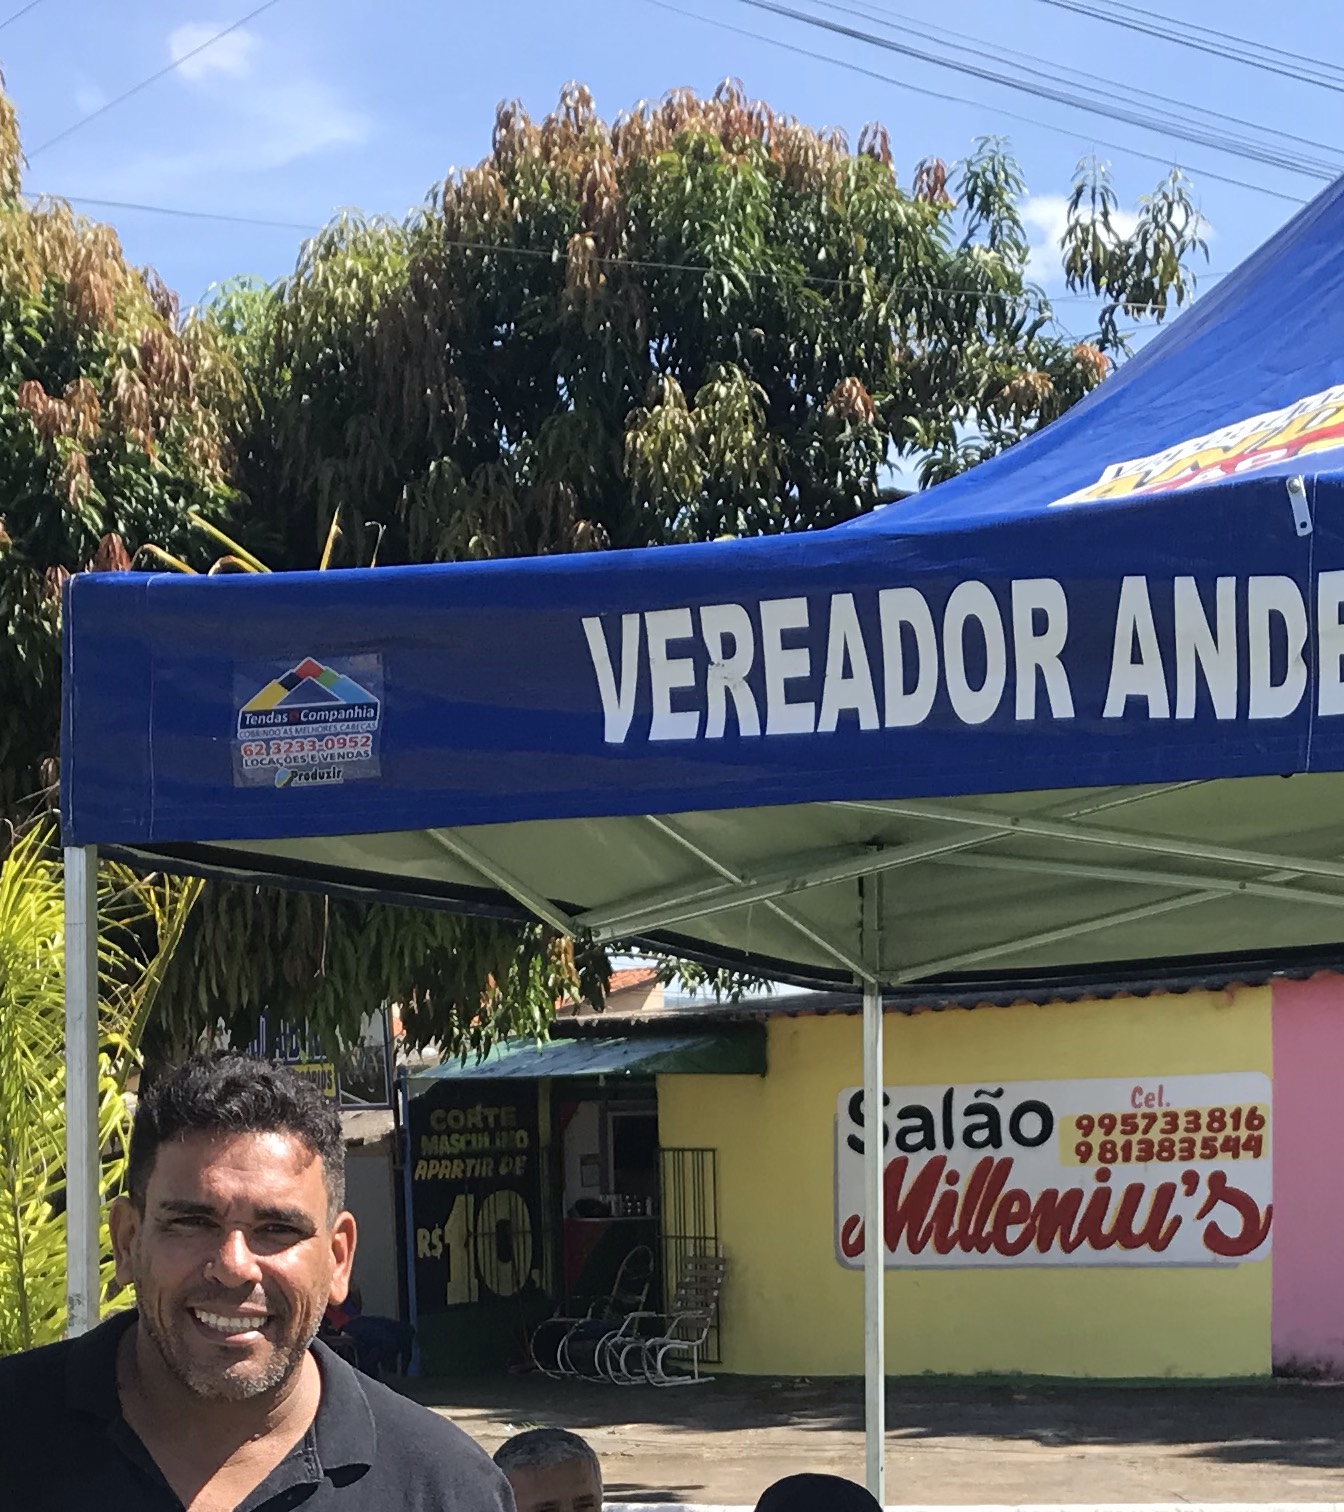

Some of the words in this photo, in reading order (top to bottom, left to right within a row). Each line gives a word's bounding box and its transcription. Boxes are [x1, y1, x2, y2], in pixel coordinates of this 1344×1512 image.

[581, 577, 1076, 744] VEREADOR
[244, 711, 289, 726] Tendas
[300, 705, 375, 722] Companhia
[241, 743, 265, 757] 62
[271, 735, 372, 755] 3233-0952
[243, 754, 307, 767] LOCAÇÕES
[310, 754, 317, 763] E
[320, 750, 371, 762] VENDAS
[1130, 1084, 1171, 1109] Cel.
[847, 1086, 1055, 1154] Salão
[1074, 1106, 1266, 1138] 995733816
[1074, 1133, 1264, 1164] 981383544
